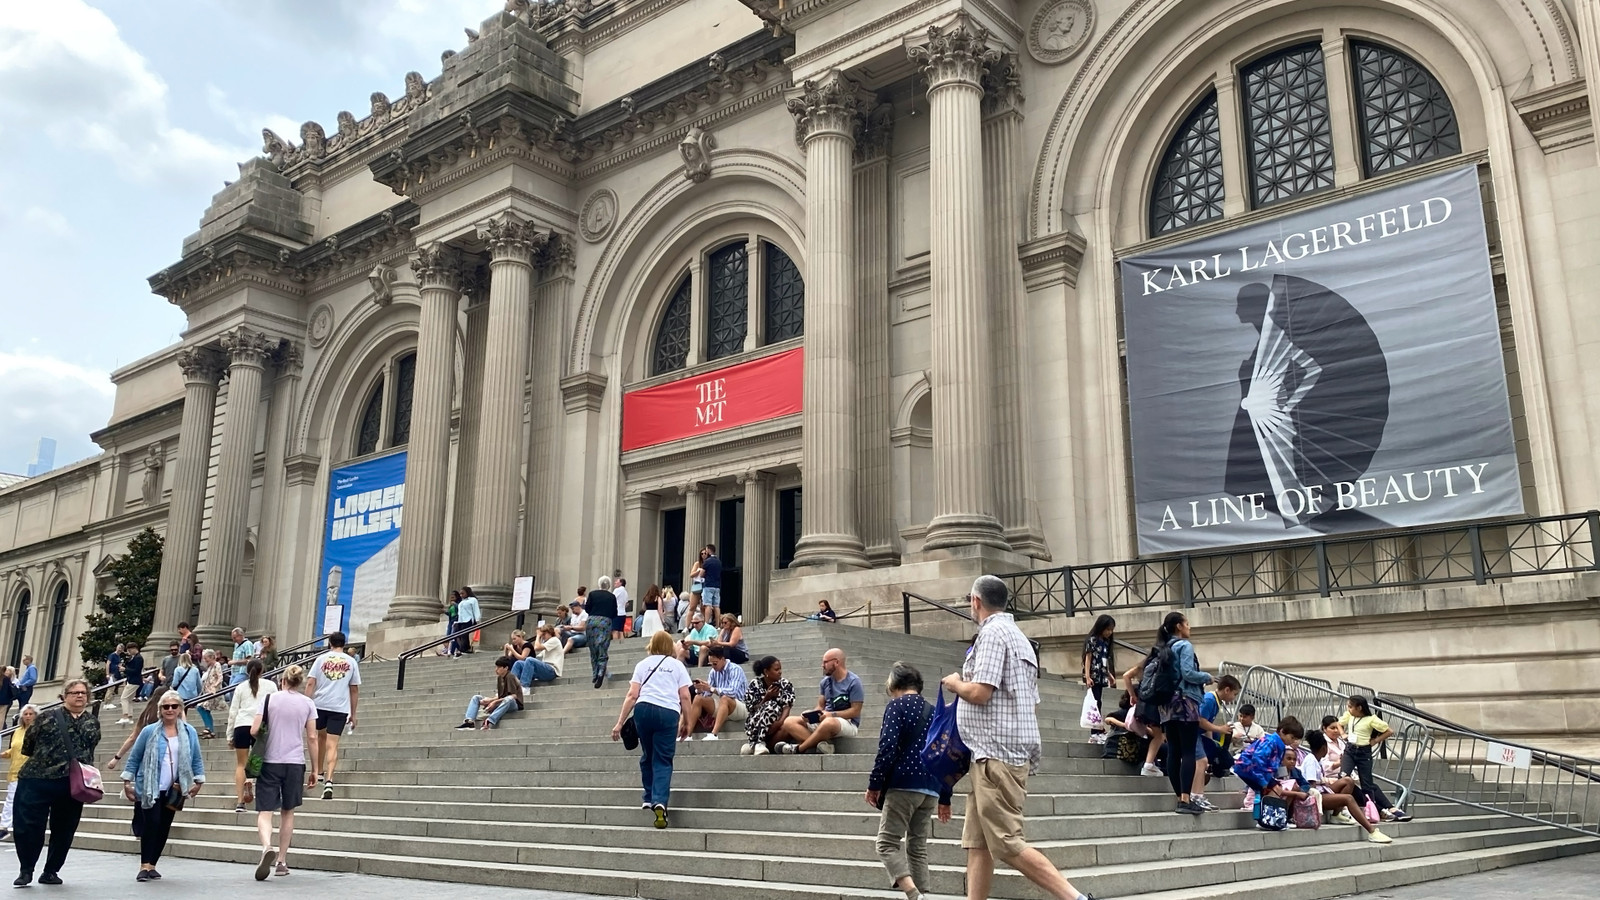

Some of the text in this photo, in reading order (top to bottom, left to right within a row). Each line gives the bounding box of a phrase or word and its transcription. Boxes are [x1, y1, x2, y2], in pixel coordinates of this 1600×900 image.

[1140, 196, 1452, 296] KARL LAGERFELD
[694, 400, 727, 427] MET
[695, 378, 726, 404] THE
[1157, 462, 1489, 532] A LINE OF BEAUTY
